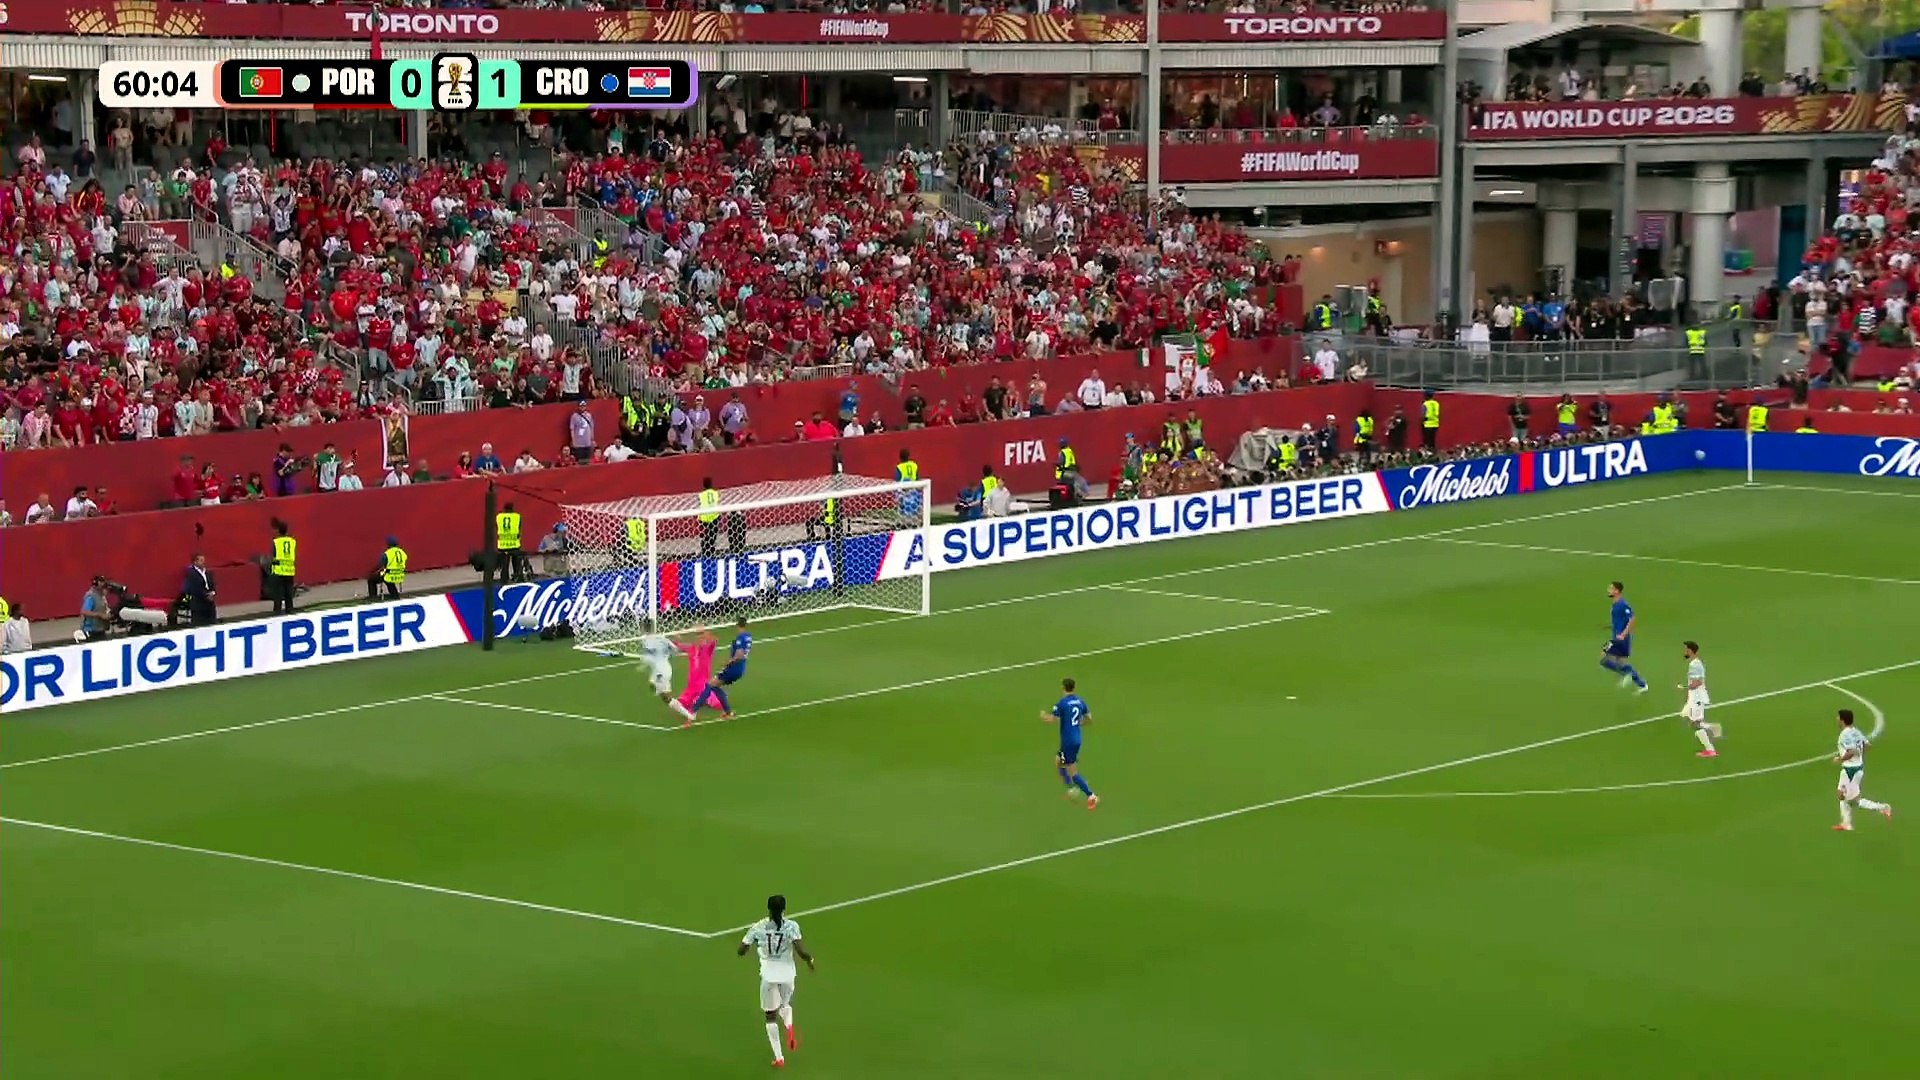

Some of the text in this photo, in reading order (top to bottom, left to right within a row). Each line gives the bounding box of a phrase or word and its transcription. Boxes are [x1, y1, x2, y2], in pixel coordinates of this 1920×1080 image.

[345, 12, 499, 35] TORONTO
[819, 18, 889, 39] #FIFAWorldCup
[1224, 16, 1382, 35] TORONTO
[1471, 105, 1735, 130] IFA WORLD CUP 2026
[1241, 150, 1360, 173] #FIFAWorldCup
[1003, 439, 1047, 466] FIFA
[1398, 439, 1648, 509] Michelob ULTRA
[904, 478, 1365, 570] A SUPERIOR LIGHT BEER
[492, 544, 836, 638] Michelob ULTRA
[82, 624, 268, 693] LIGHT
[281, 602, 427, 663] BEER
[1071, 706, 1080, 727] 2
[765, 932, 784, 955] 17
